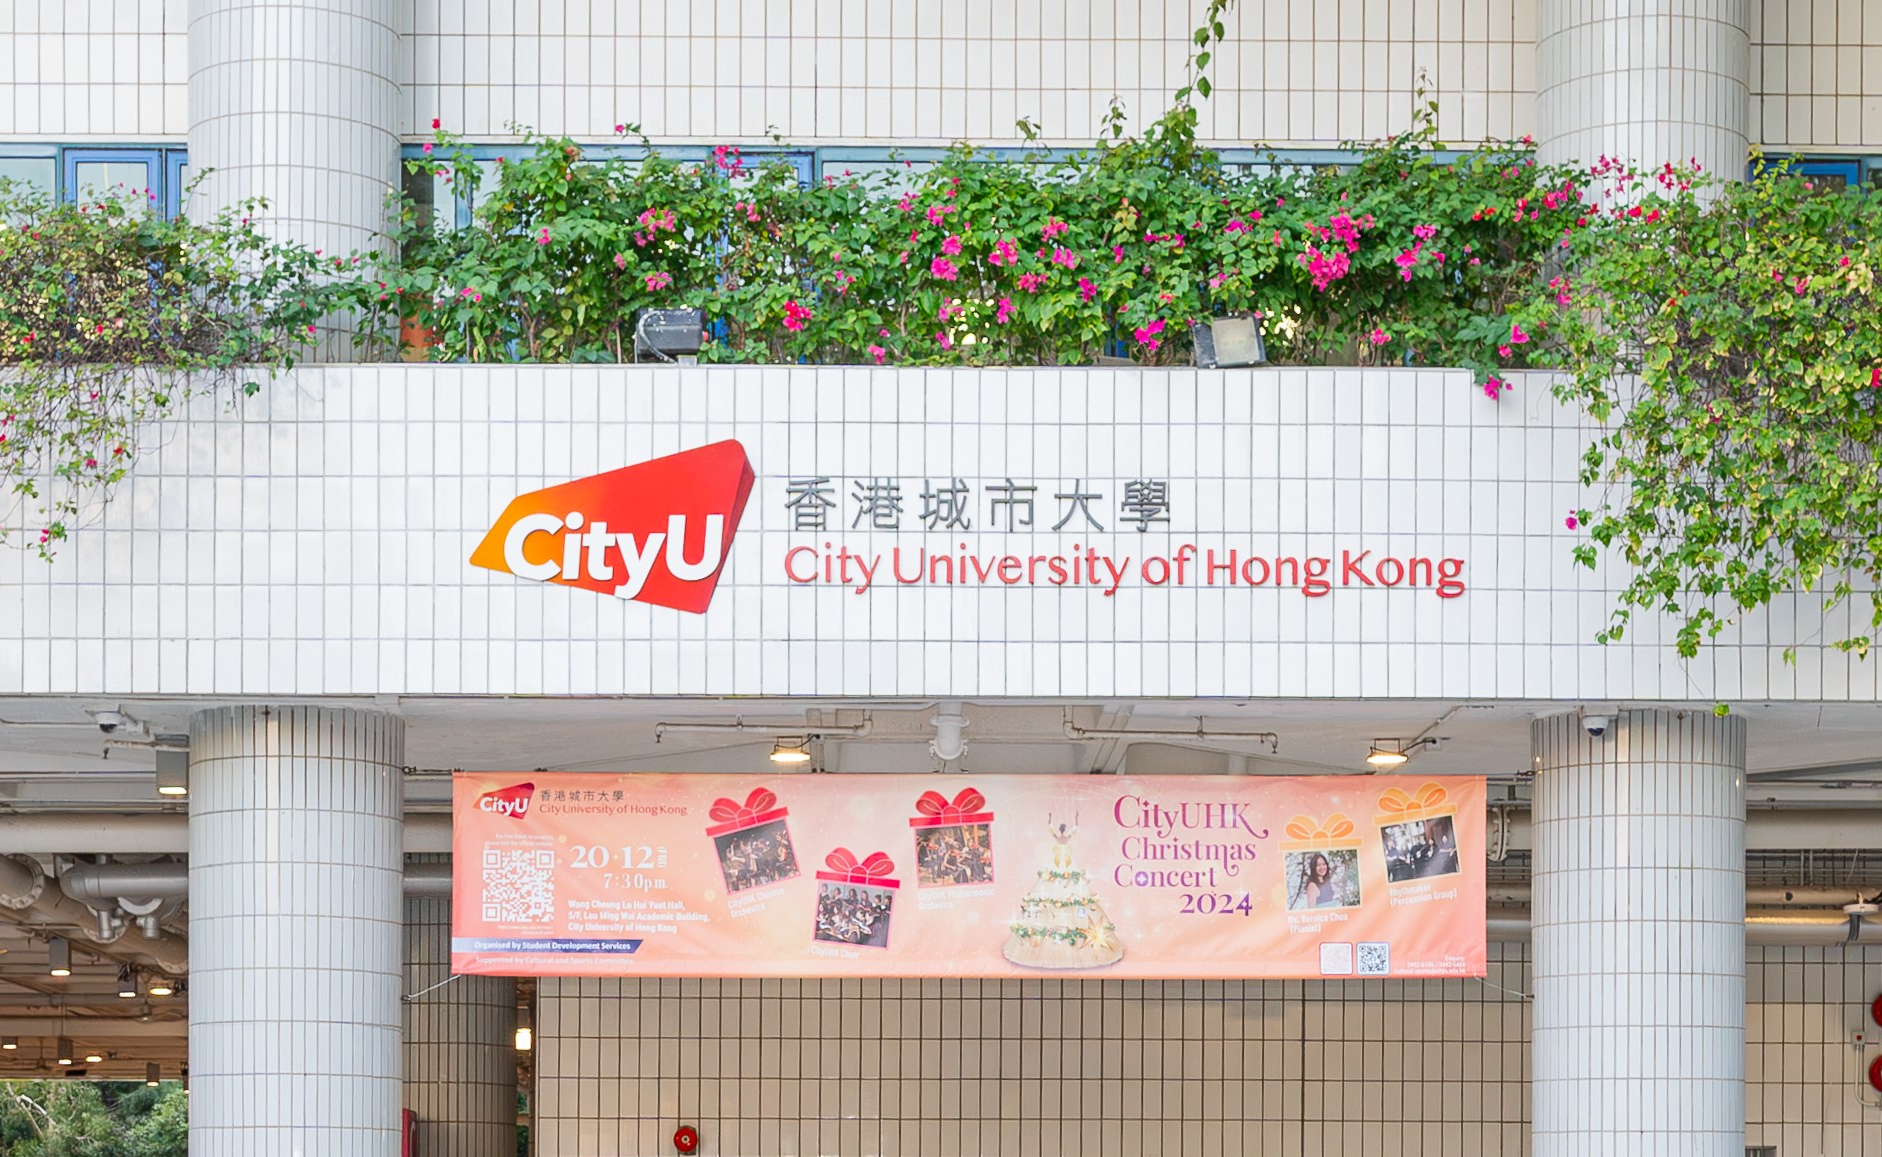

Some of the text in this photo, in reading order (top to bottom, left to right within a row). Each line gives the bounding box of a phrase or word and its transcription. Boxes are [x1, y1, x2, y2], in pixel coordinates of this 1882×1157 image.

[785, 477, 1170, 532] 香港城市大學
[504, 512, 724, 599] CityU
[785, 542, 1465, 599] City University of Hong Kong
[479, 797, 528, 816] CityU
[540, 790, 624, 802] 香港城市大學
[539, 803, 688, 816] City University of Hong Kong
[1114, 795, 1269, 839] CityUHK
[1121, 836, 1256, 876] Christmas
[1114, 864, 1217, 888] Concert
[1179, 892, 1253, 916] 2024
[568, 923, 583, 934] City
[585, 922, 625, 934] University
[626, 923, 634, 932] of
[635, 923, 656, 934] Hong
[657, 923, 677, 934] Kong
[600, 912, 619, 923] Ming
[636, 912, 674, 921] Academic
[475, 941, 631, 951] Organised by Student Development Services
